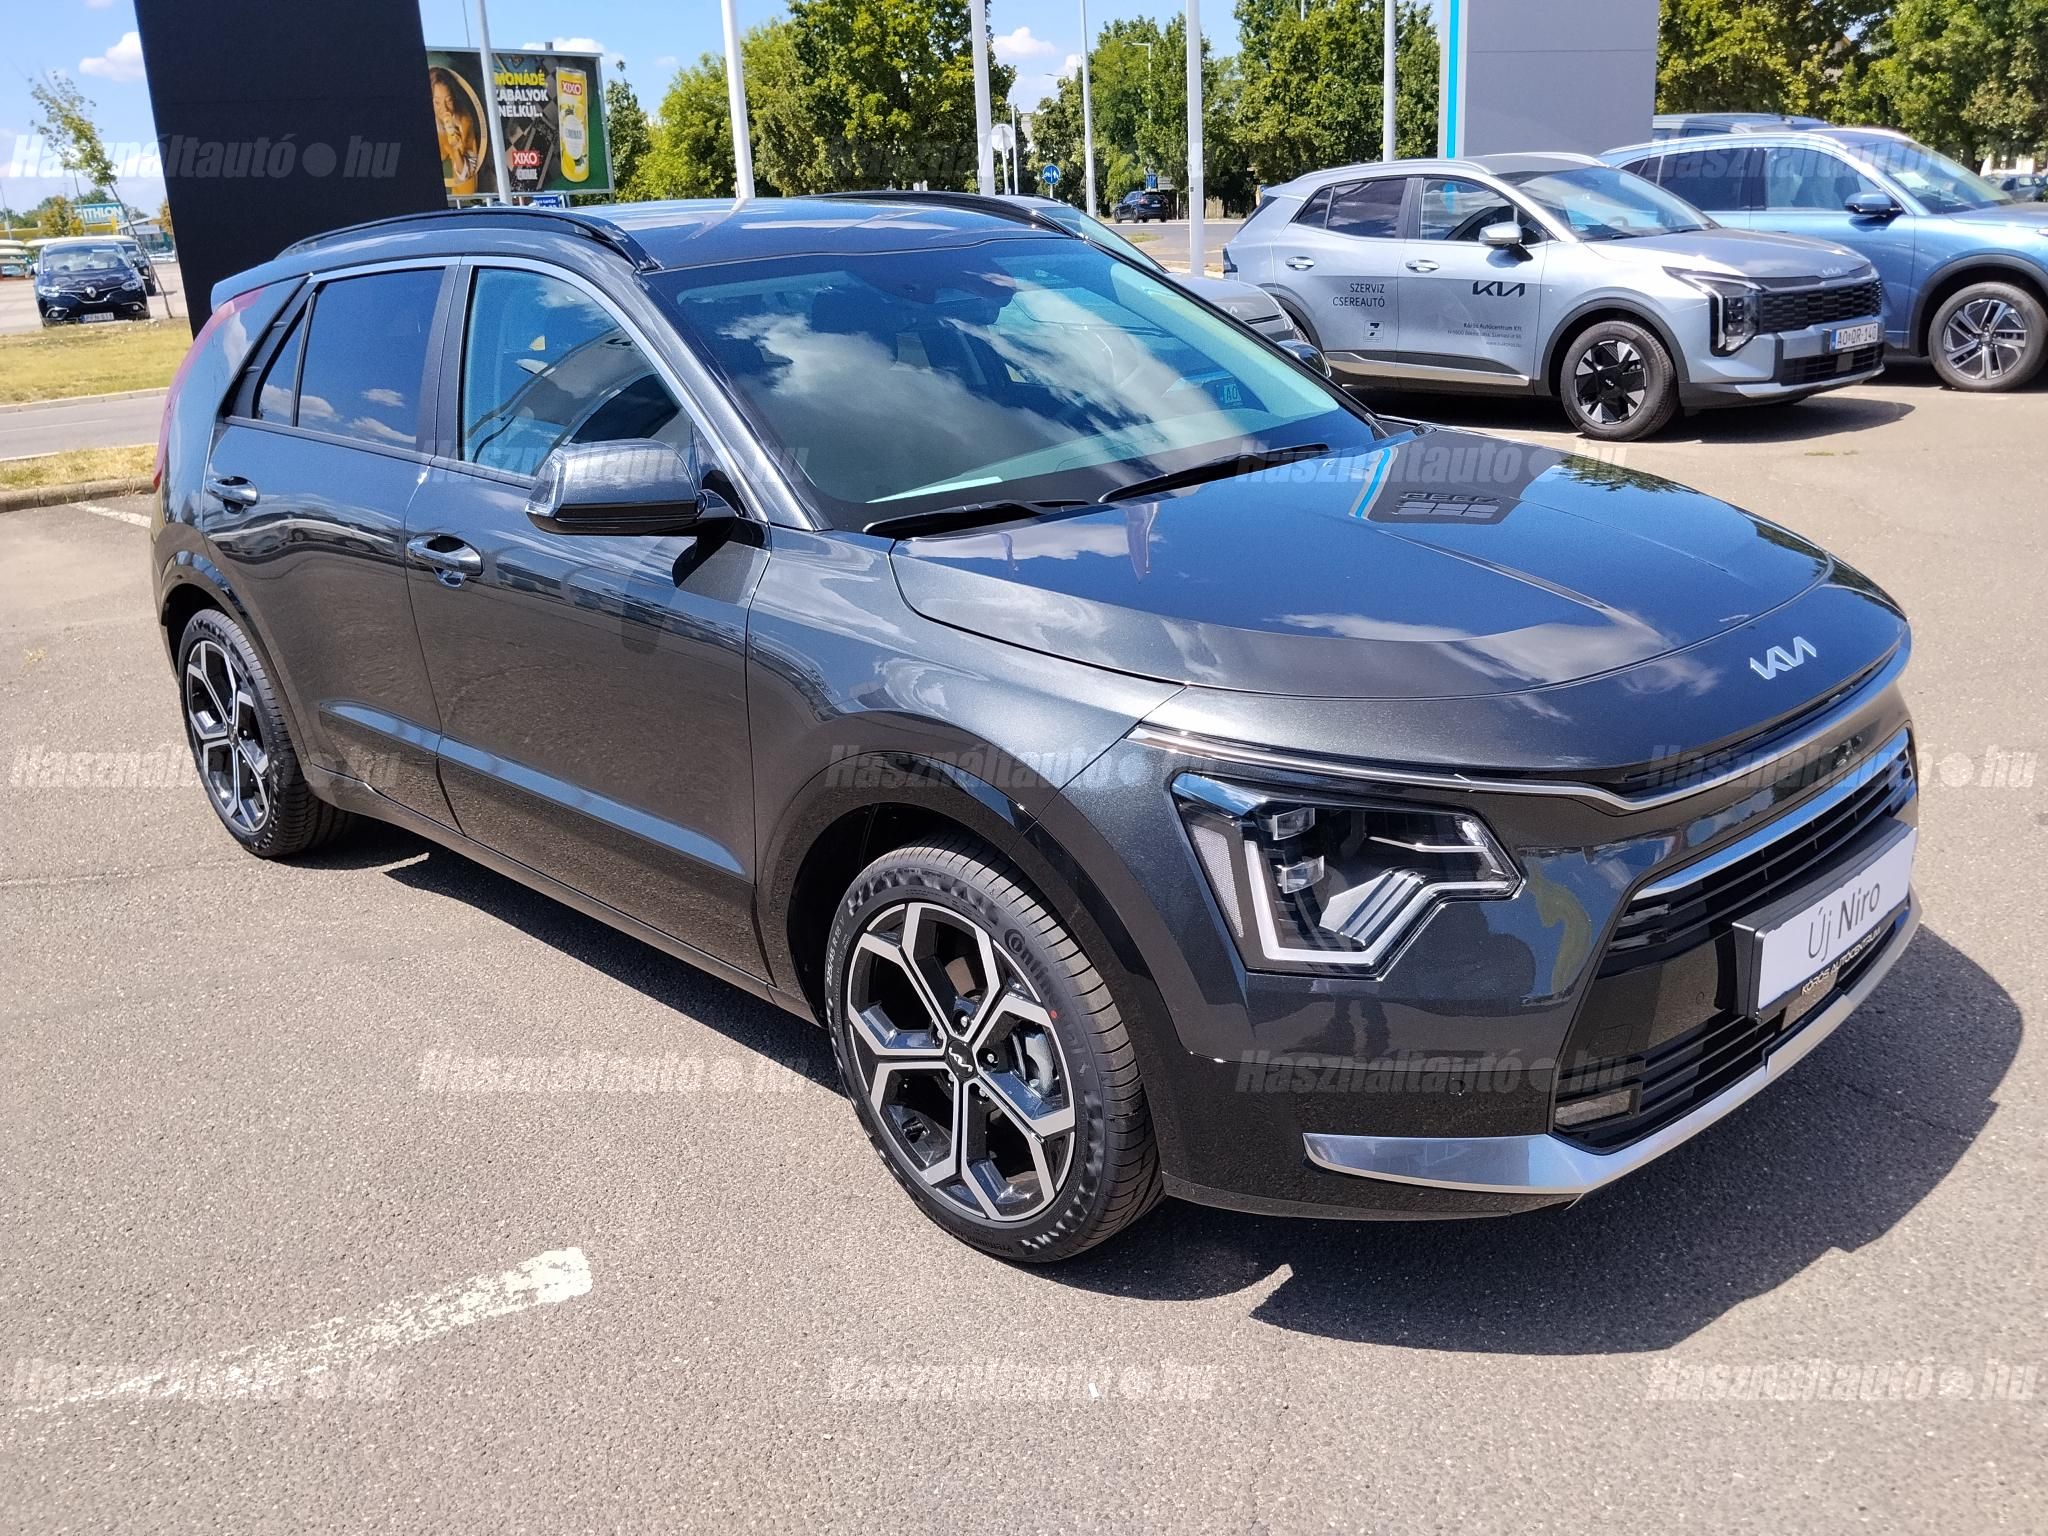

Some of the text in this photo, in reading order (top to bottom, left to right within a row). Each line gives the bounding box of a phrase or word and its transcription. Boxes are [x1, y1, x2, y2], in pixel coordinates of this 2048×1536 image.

[513, 152, 538, 165] XIXO
[1350, 283, 1385, 294] SZERVIZ
[1472, 281, 1526, 298] KIA
[1333, 295, 1385, 308] CSEREAUTÓ
[1807, 883, 1880, 962] Új Niro
